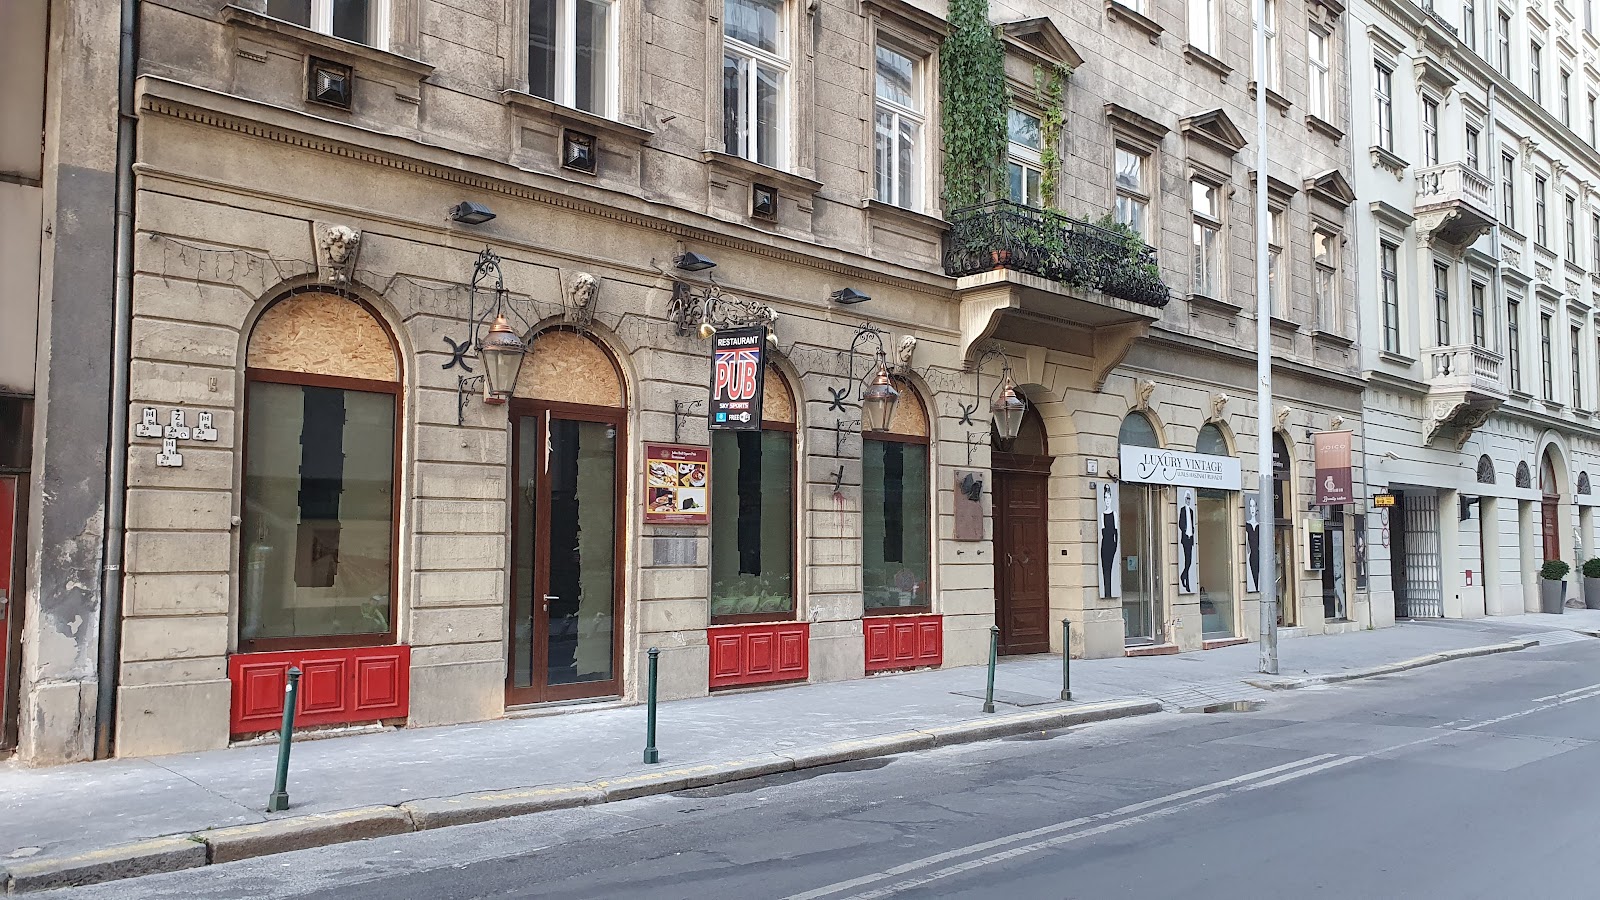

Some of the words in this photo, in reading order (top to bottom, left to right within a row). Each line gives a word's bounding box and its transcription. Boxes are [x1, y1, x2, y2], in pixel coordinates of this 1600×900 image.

[717, 336, 758, 346] RESTAURANT
[714, 360, 757, 400] PUB
[1185, 458, 1222, 472] VINTAGE
